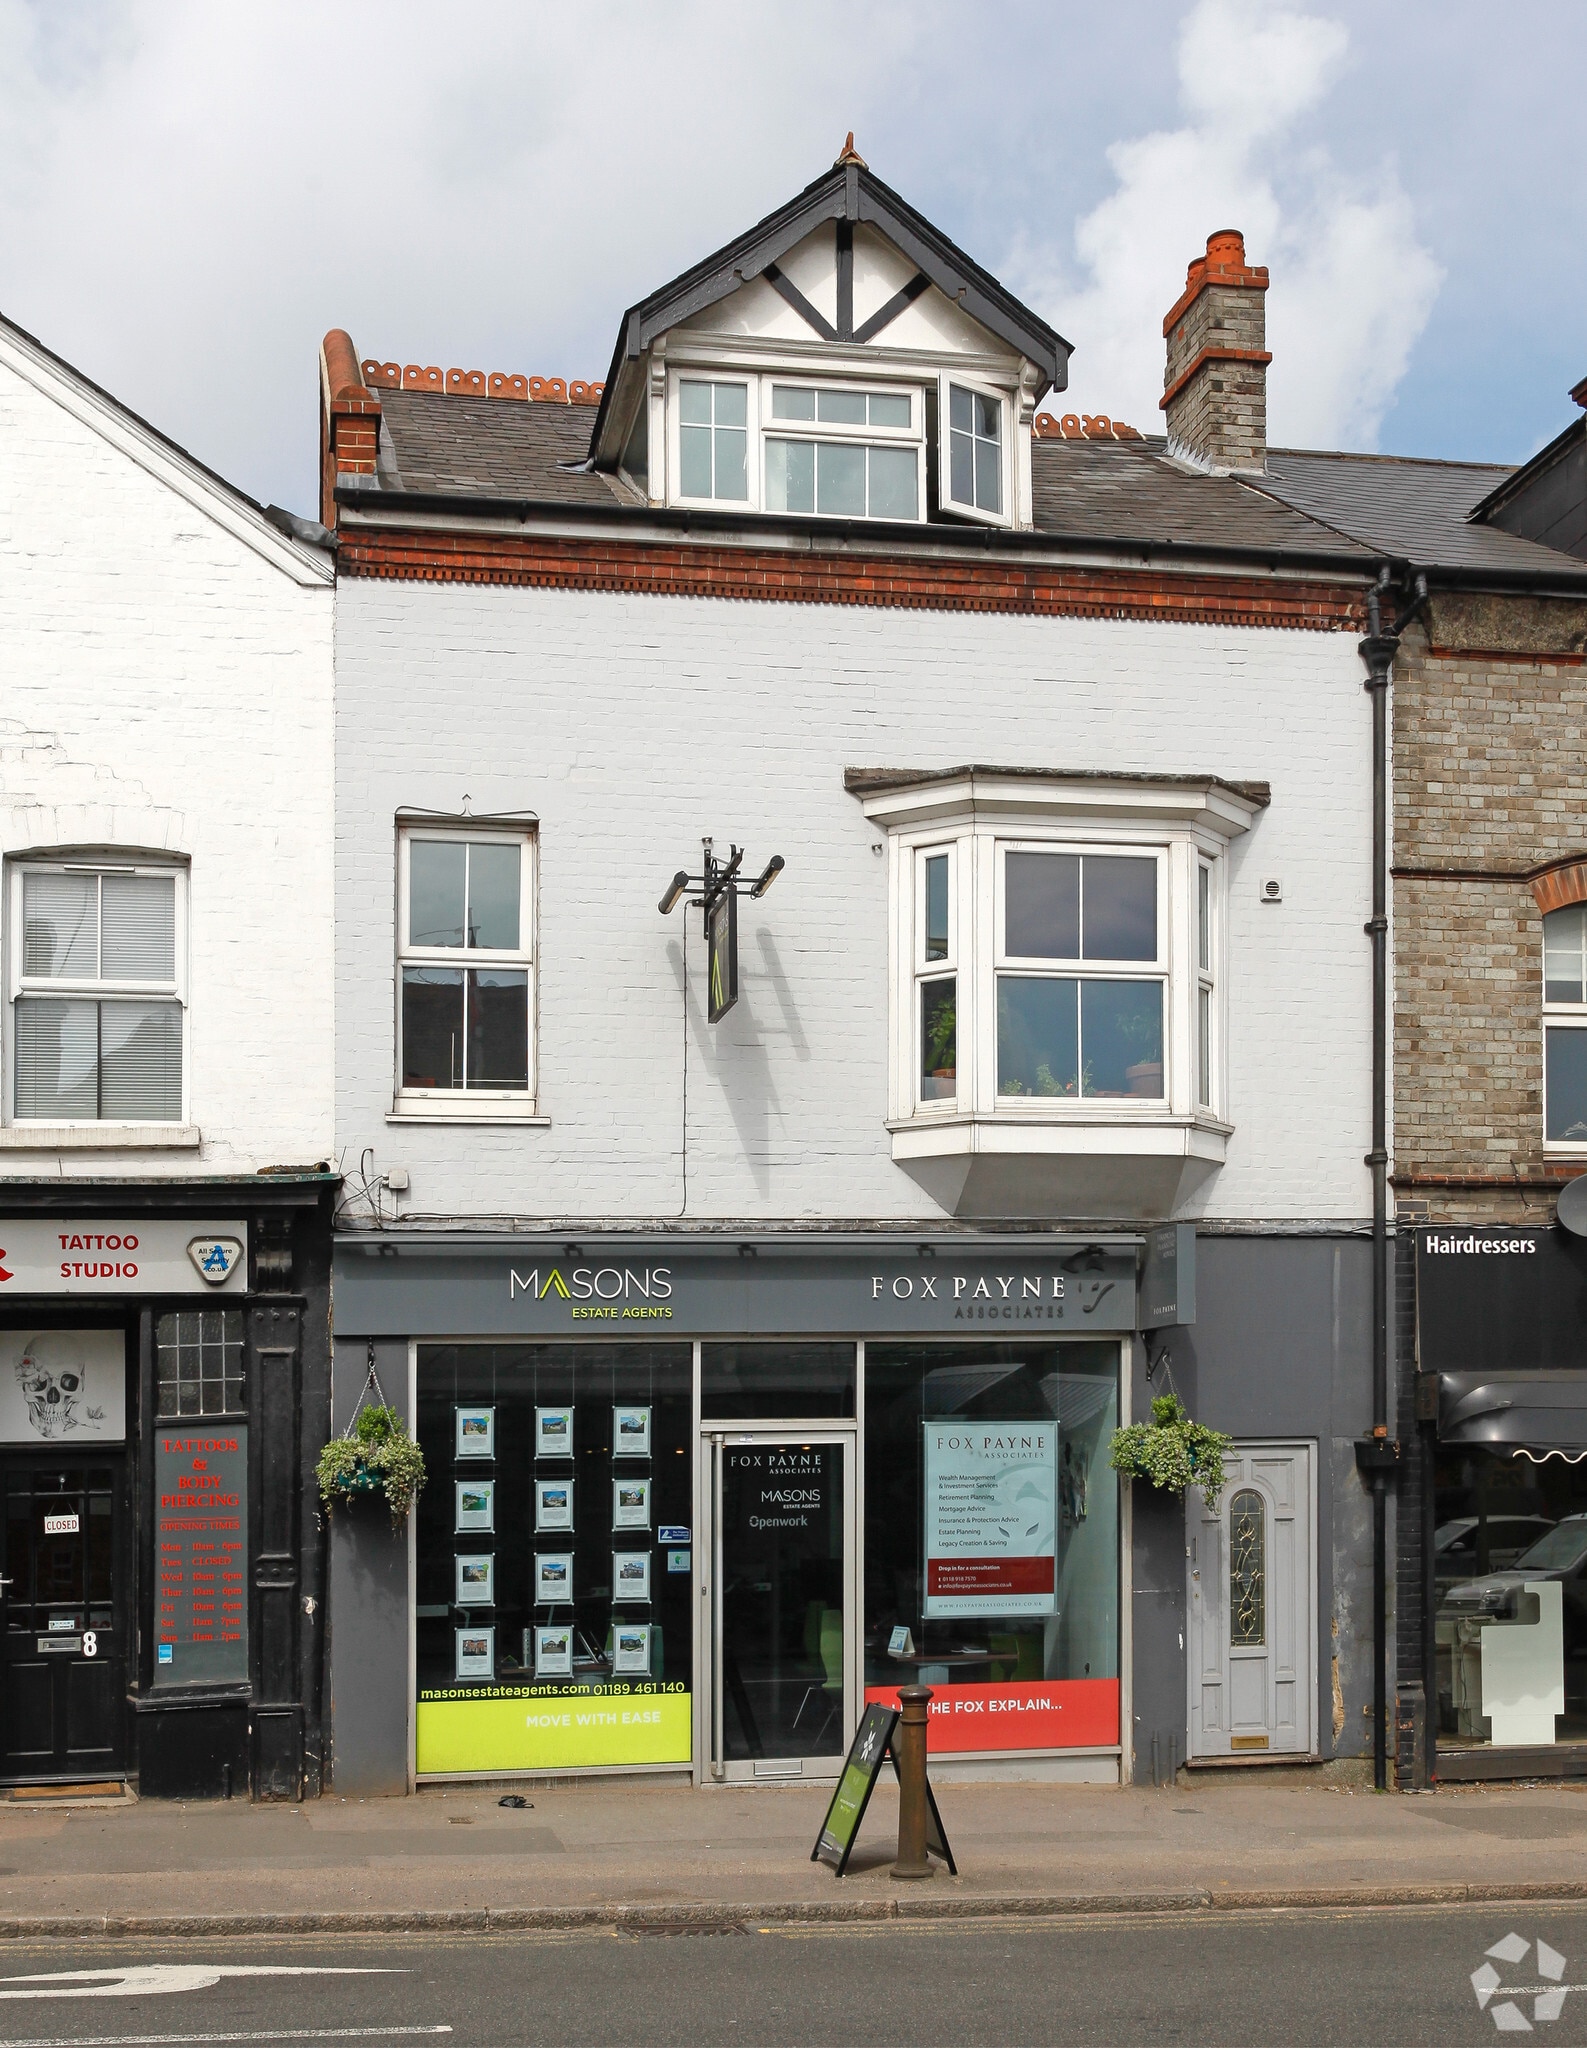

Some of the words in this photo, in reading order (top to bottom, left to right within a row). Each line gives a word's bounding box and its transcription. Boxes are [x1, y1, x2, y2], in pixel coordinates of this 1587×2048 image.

[58, 1235, 139, 1250] TATTOO
[1426, 1235, 1536, 1254] Hairdressers
[60, 1262, 139, 1278] STUDIO
[510, 1268, 672, 1299] MASONS
[871, 1276, 938, 1299] FOX
[952, 1276, 1065, 1298] PAYNE
[572, 1307, 618, 1318] ESTATE
[621, 1307, 673, 1318] AGENTS
[954, 1305, 1064, 1319] ASSOCIATES
[161, 1438, 239, 1453] TATTOOS
[937, 1437, 973, 1449] FOX
[983, 1436, 1045, 1449] PAYNE
[192, 1457, 208, 1471] &
[730, 1456, 761, 1467] FOX
[768, 1454, 821, 1466] PAYNE
[178, 1474, 222, 1489] BODY
[161, 1493, 239, 1508] PIERCING
[761, 1488, 821, 1503] MASONS
[46, 1520, 78, 1531] CLOSED
[160, 1522, 207, 1531] OPENING
[209, 1521, 240, 1530] TIMES
[749, 1514, 808, 1530] Openwork
[988, 1539, 1008, 1547] Saving
[192, 1556, 233, 1565] CLOSED
[83, 1631, 97, 1657] 8
[421, 1683, 590, 1699] masonsestateagents.com
[593, 1683, 630, 1695] 01189
[634, 1682, 657, 1694] 461
[661, 1681, 685, 1693] 140
[955, 1701, 984, 1713] FOX
[989, 1698, 1062, 1712] EXPLAIN...
[526, 1715, 571, 1728] MOVE
[575, 1712, 617, 1725] WITH
[622, 1711, 662, 1724] EASE
